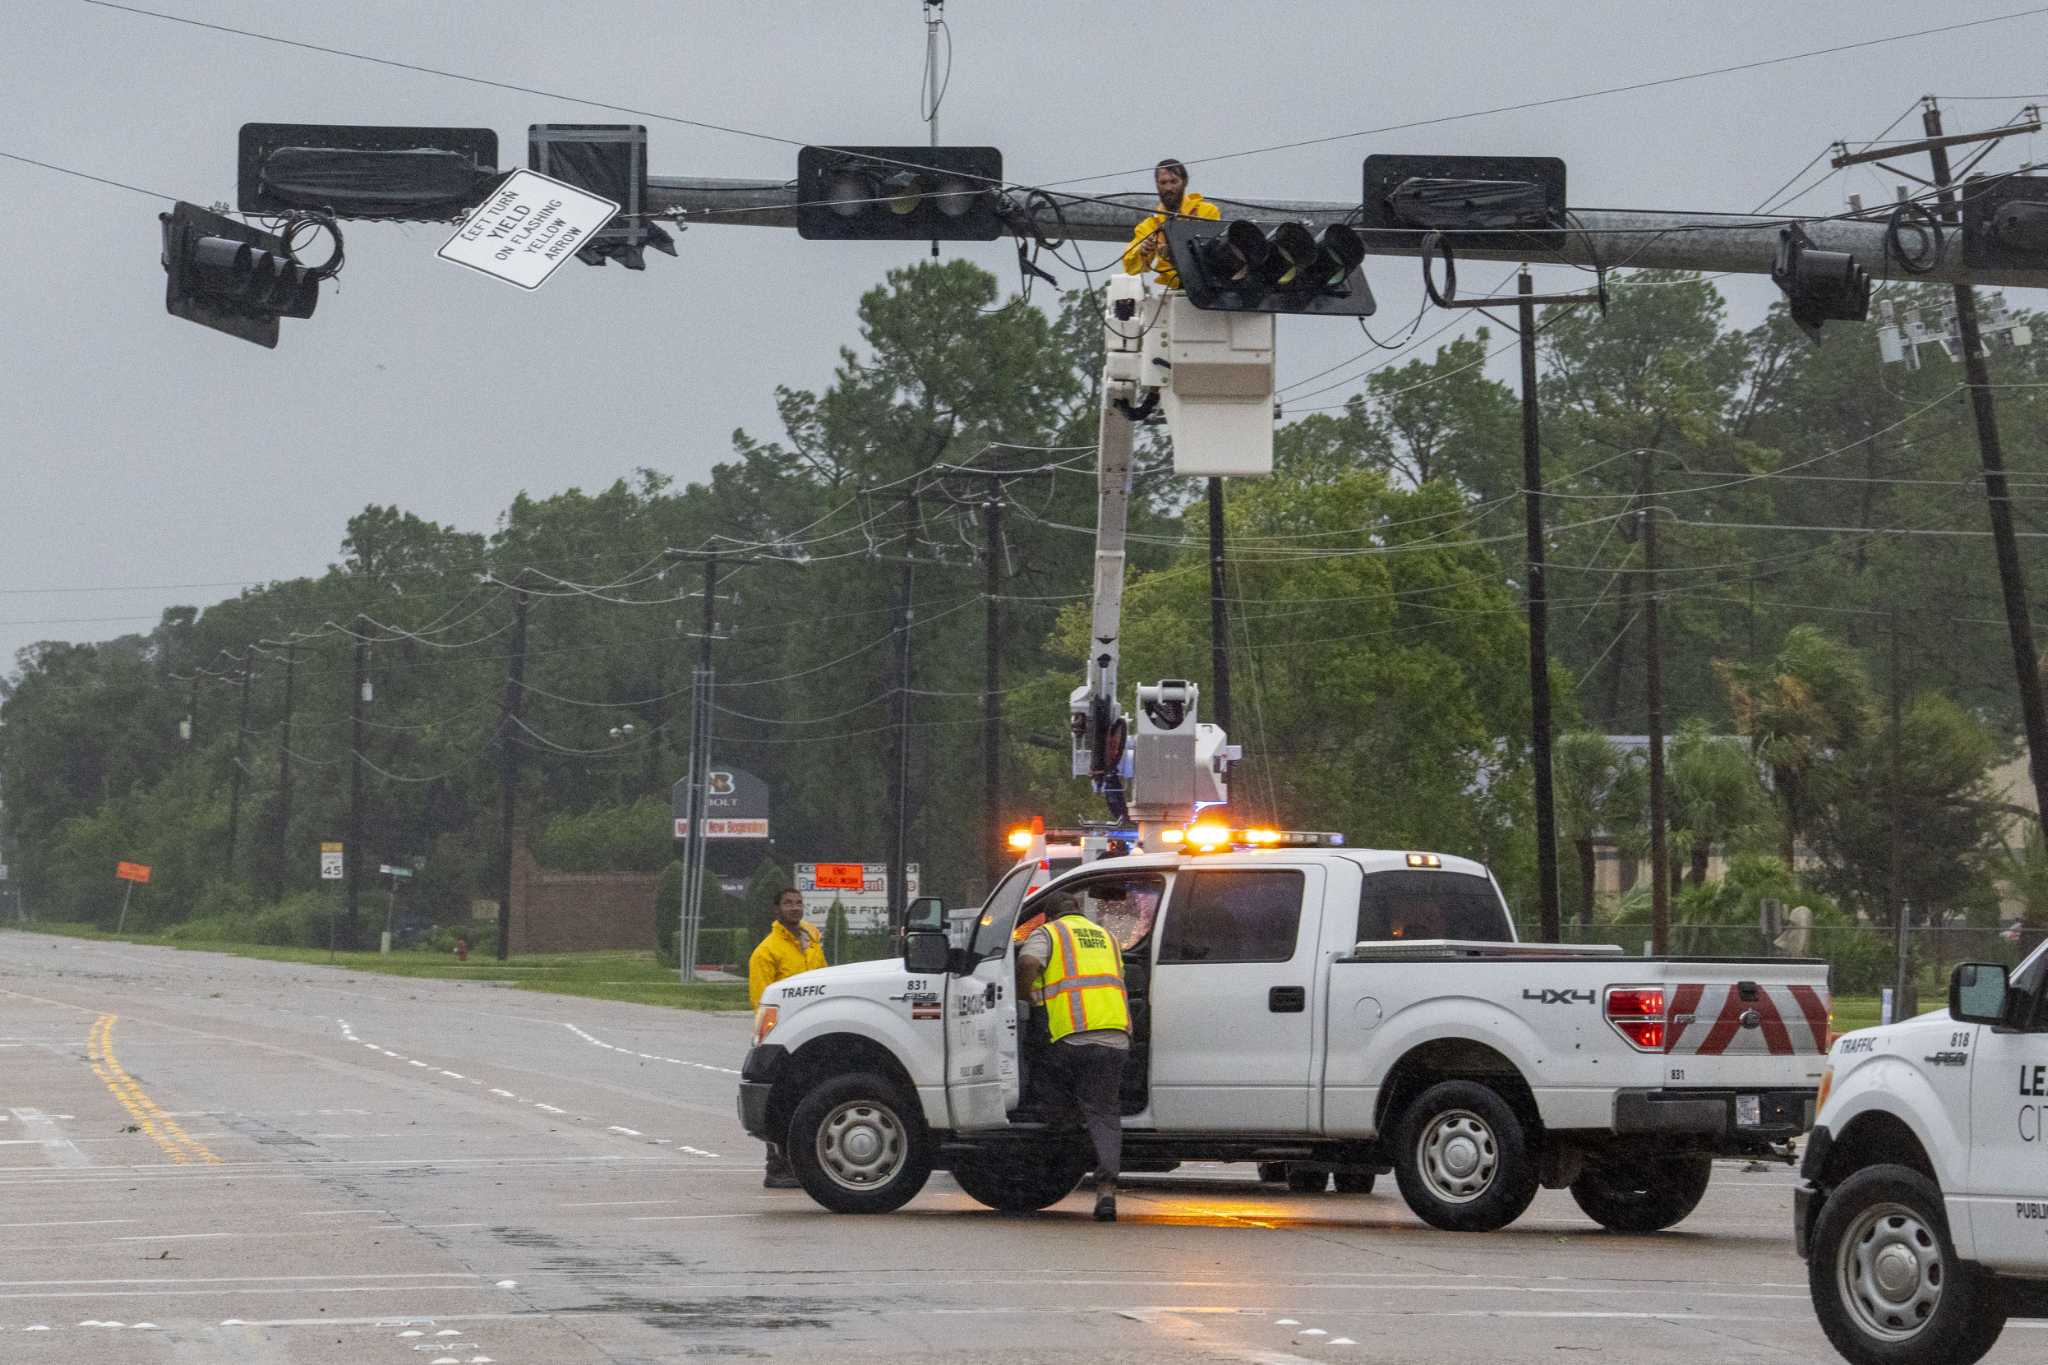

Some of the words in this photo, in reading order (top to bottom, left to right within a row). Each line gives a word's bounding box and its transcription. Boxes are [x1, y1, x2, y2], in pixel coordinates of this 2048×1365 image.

[460, 217, 491, 241] LEFT
[488, 191, 519, 215] TURN
[487, 205, 531, 239] YIELD
[495, 246, 515, 261] ON
[511, 199, 562, 244] FLASHING
[524, 217, 567, 254] YELLOW
[544, 227, 582, 260] ARROW
[323, 865, 342, 876] 45
[1078, 938, 1107, 949] TRAFFIC
[782, 984, 827, 998] TRAFFIC
[906, 980, 927, 990] 831
[1840, 1036, 1877, 1055] TRAFFIC
[1950, 1032, 1970, 1047] 818
[1671, 1069, 1685, 1080] 831
[2019, 1065, 2048, 1097] LE
[2016, 1202, 2048, 1220] PUBLI
